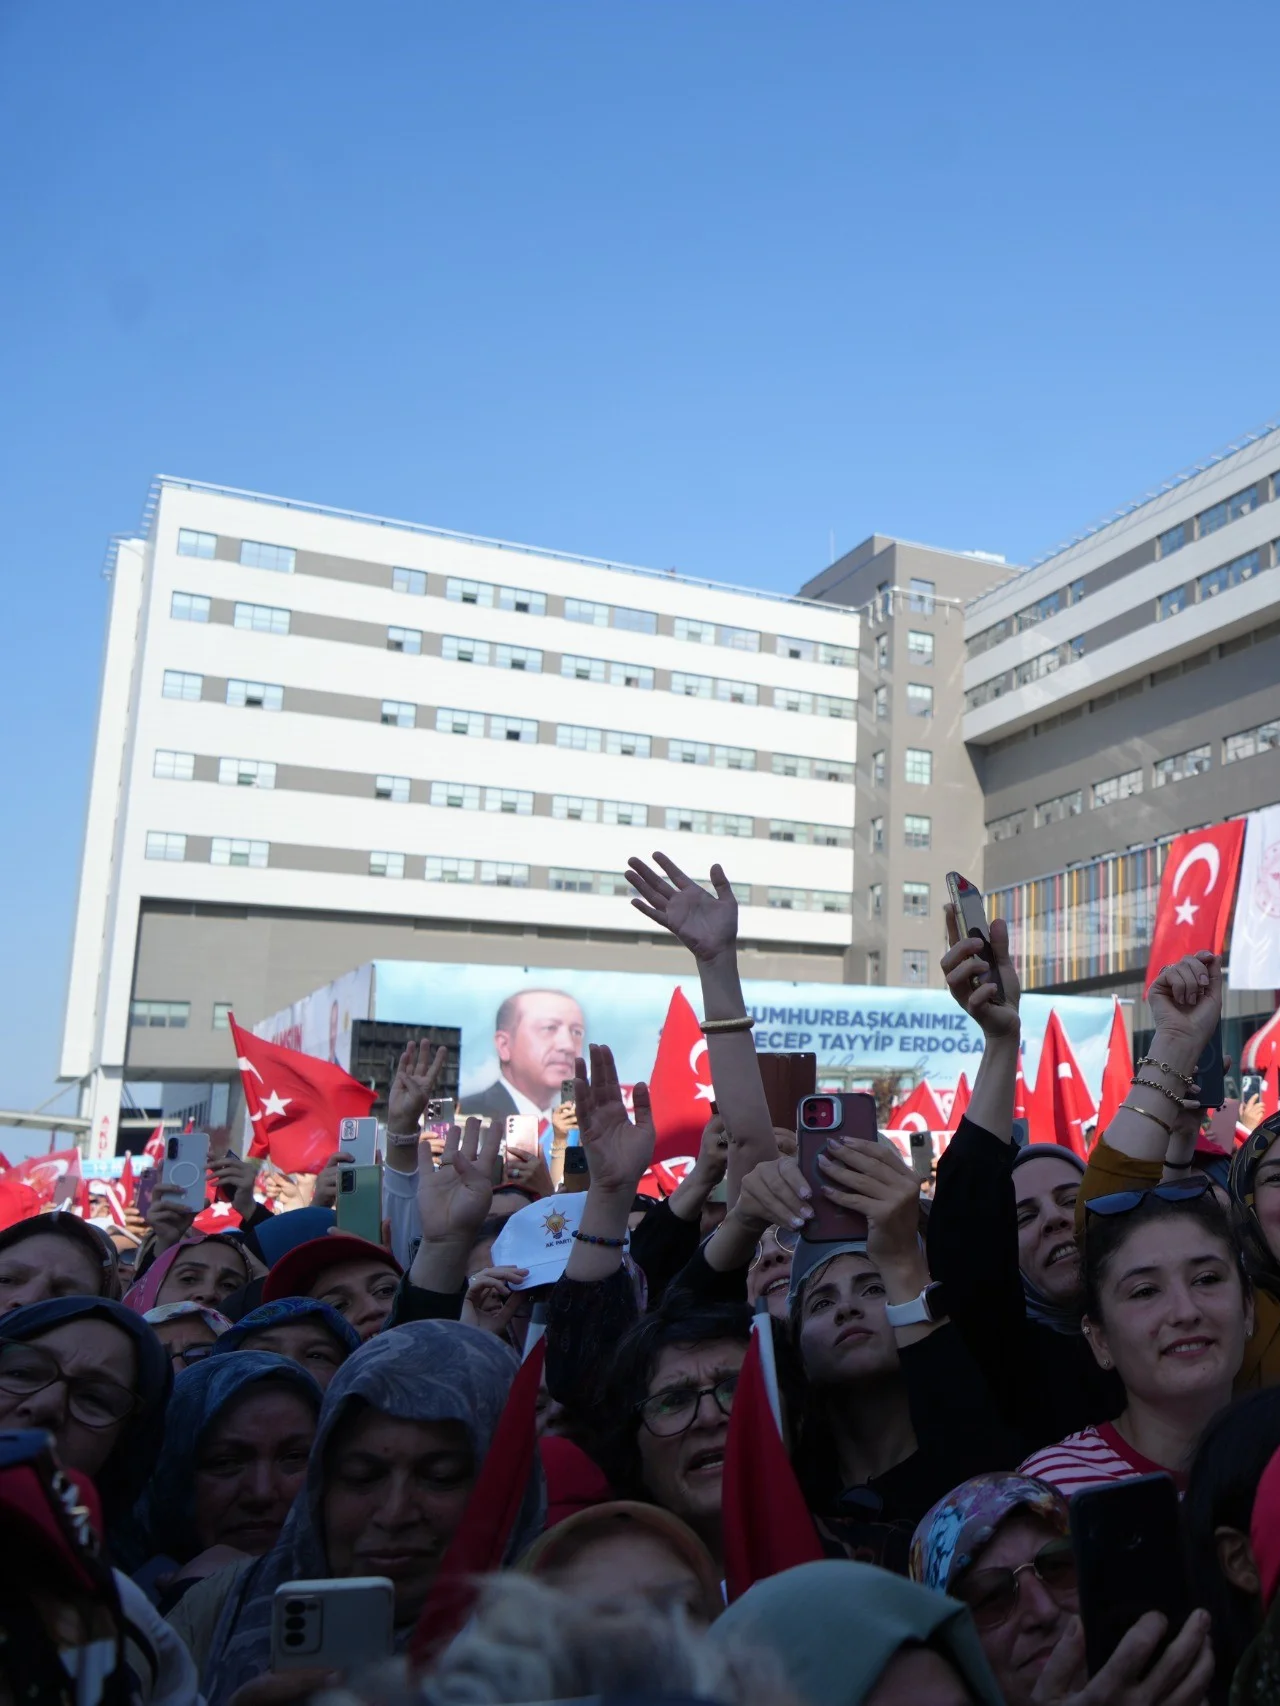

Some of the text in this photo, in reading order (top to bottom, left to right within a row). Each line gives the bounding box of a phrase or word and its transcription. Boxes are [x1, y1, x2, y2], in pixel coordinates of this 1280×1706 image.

[746, 1006, 967, 1031] UMHURBAŞKANIMIZ
[754, 1031, 813, 1049] ECEP
[818, 1030, 894, 1052] TAYYİP
